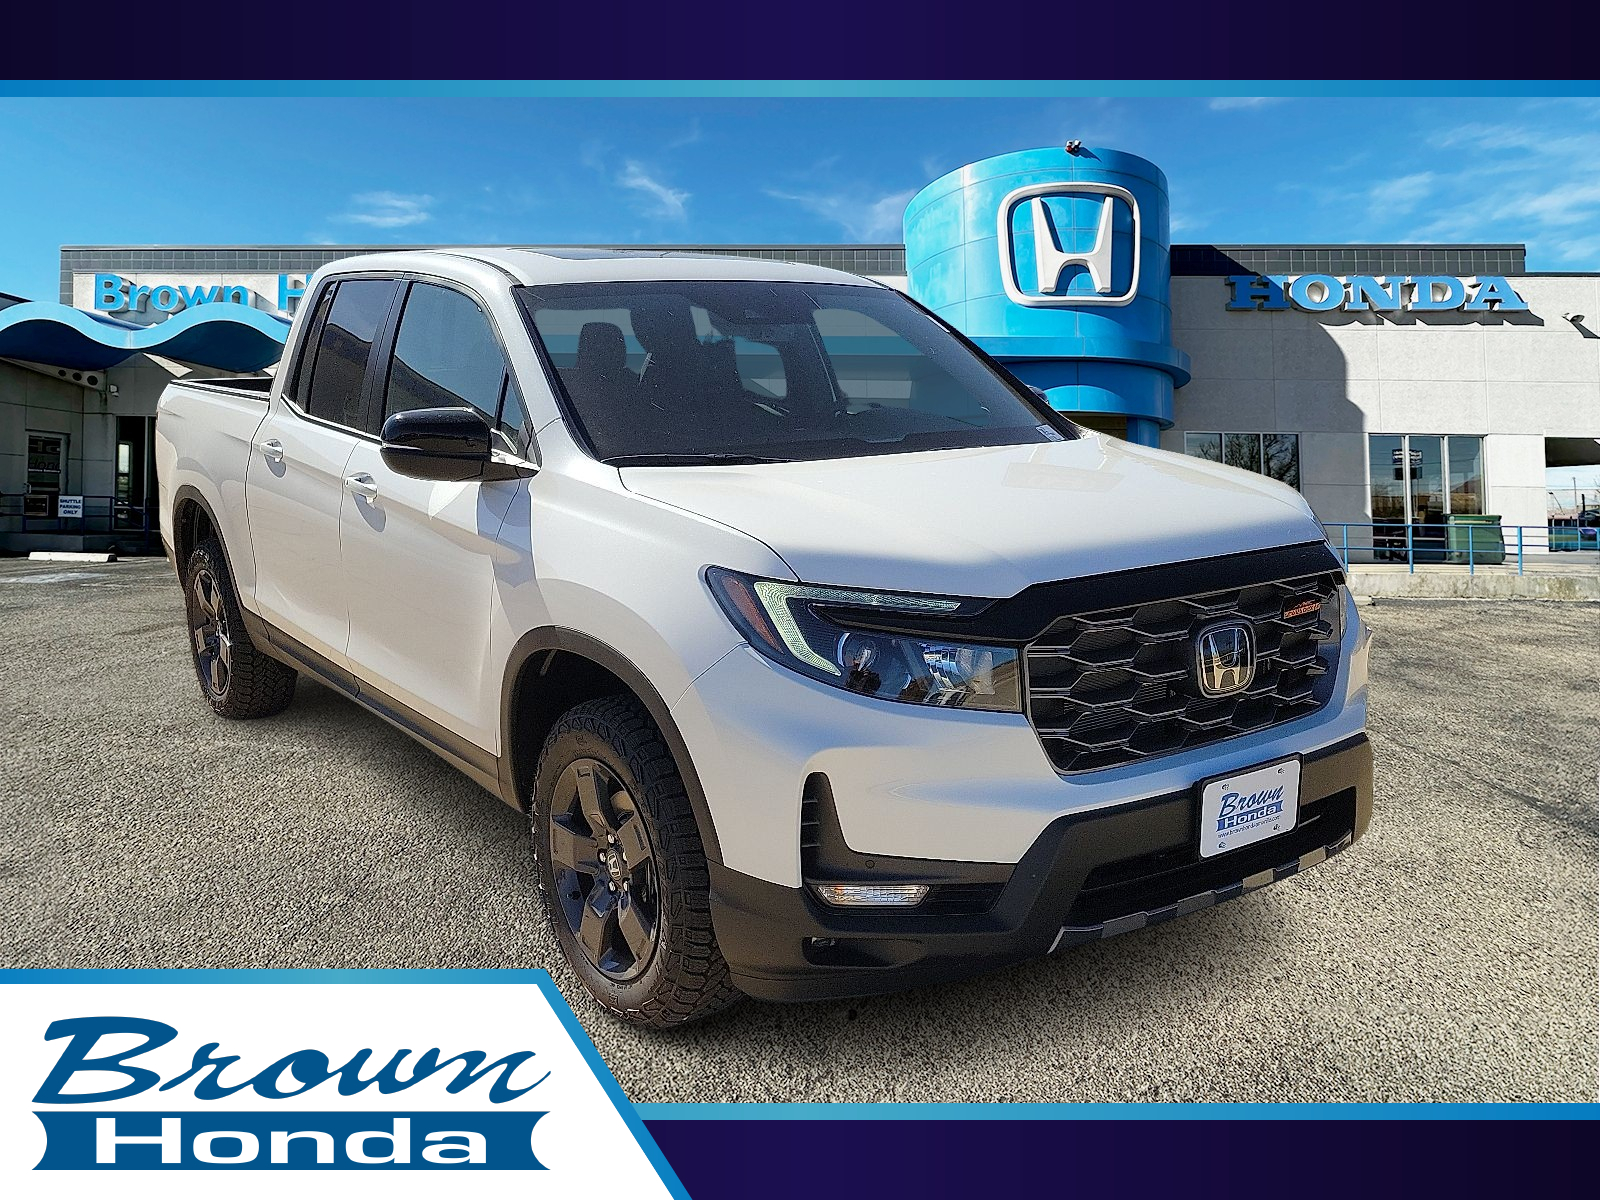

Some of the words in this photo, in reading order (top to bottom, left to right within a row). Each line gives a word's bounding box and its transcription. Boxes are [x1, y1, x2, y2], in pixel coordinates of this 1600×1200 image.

[94, 273, 250, 312] Brown
[278, 274, 316, 312] H
[1226, 273, 1529, 311] HONDA
[1218, 785, 1284, 819] Brown
[1224, 805, 1277, 829] Honda
